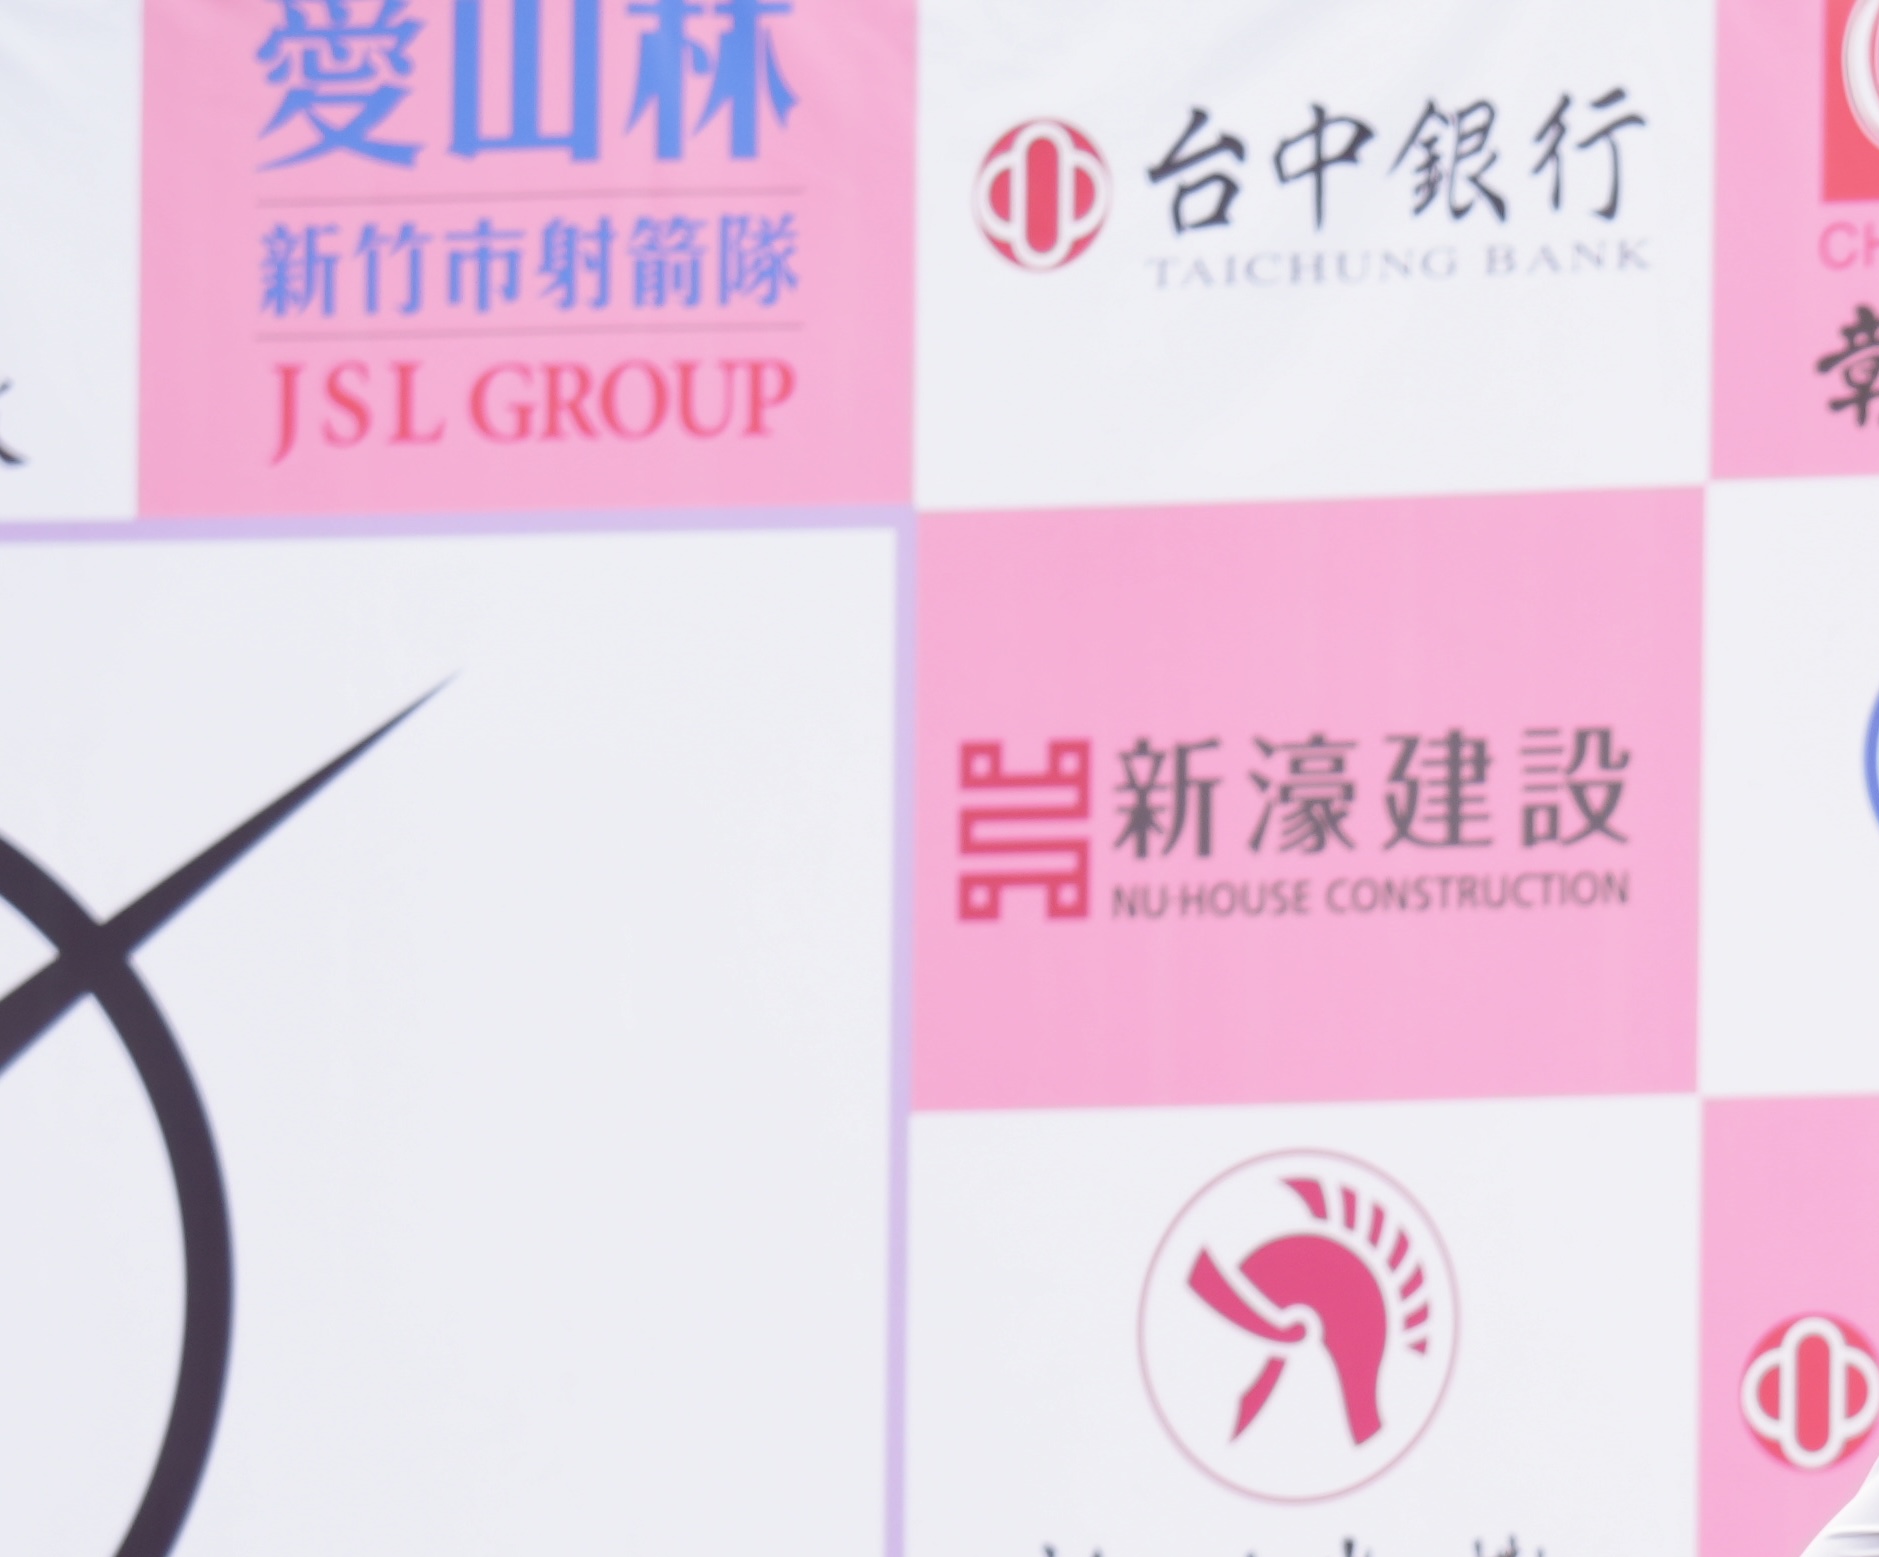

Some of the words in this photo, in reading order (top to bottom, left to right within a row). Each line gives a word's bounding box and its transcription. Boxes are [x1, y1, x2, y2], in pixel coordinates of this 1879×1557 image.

[255, 0, 800, 171] 愛山林
[1146, 86, 1648, 235] 台中銀行
[258, 211, 801, 318] 新竹市射箭隊
[1145, 244, 1459, 290] TAICHUNG
[1483, 237, 1651, 277] BANK
[269, 359, 446, 467] JSL
[468, 357, 797, 446] GROUP
[1111, 726, 1632, 860] 新濠建設
[1325, 871, 1631, 916] CONSTRUCTION
